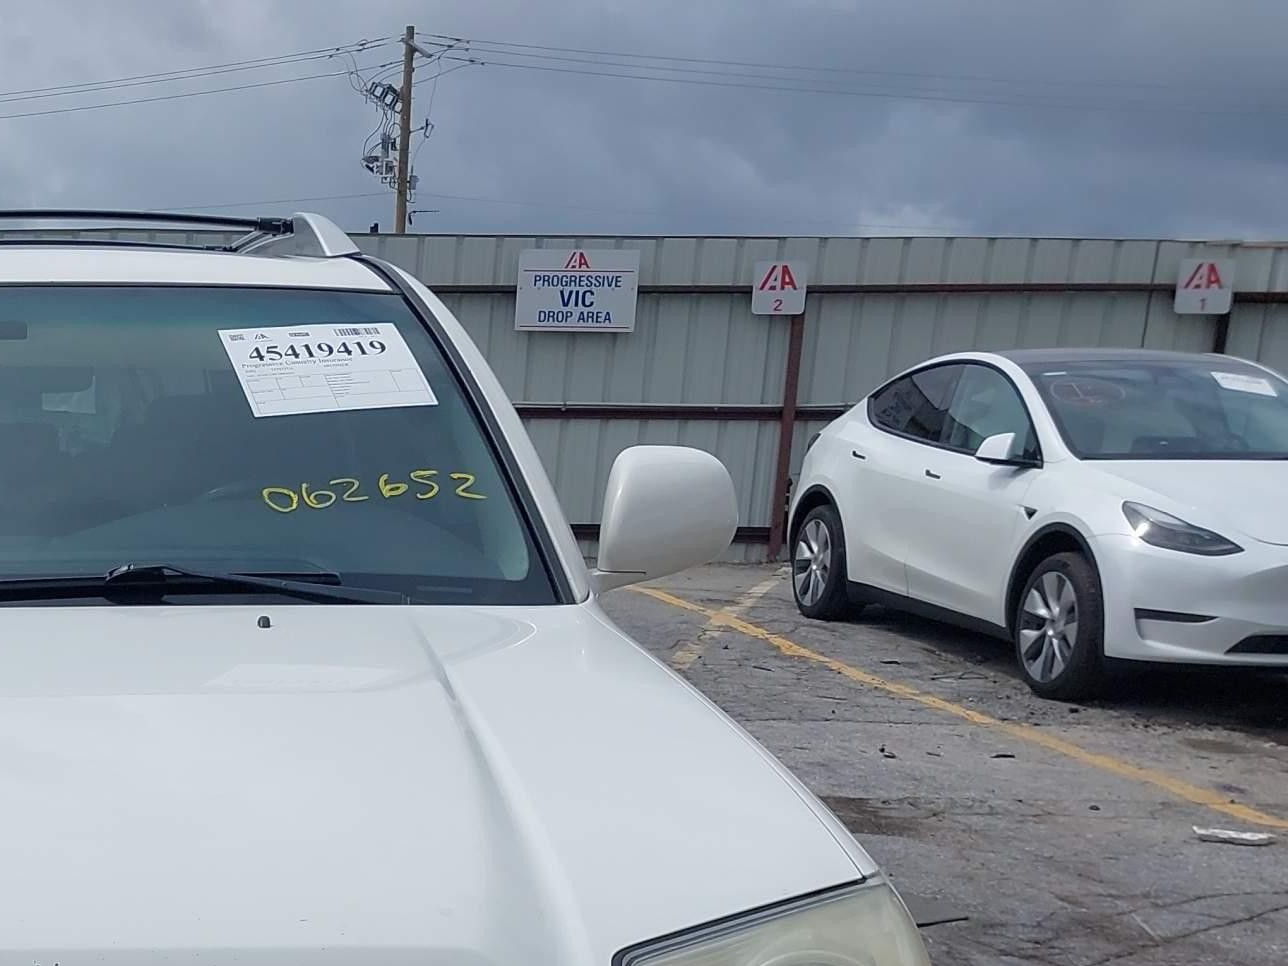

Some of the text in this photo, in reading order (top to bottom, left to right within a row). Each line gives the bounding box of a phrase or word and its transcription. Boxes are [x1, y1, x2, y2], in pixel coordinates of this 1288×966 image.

[533, 274, 623, 288] PROGRESSIVE
[560, 289, 595, 308] VIC
[773, 299, 784, 312] 2
[537, 310, 613, 324] DROP AREA
[249, 340, 386, 362] 45419419
